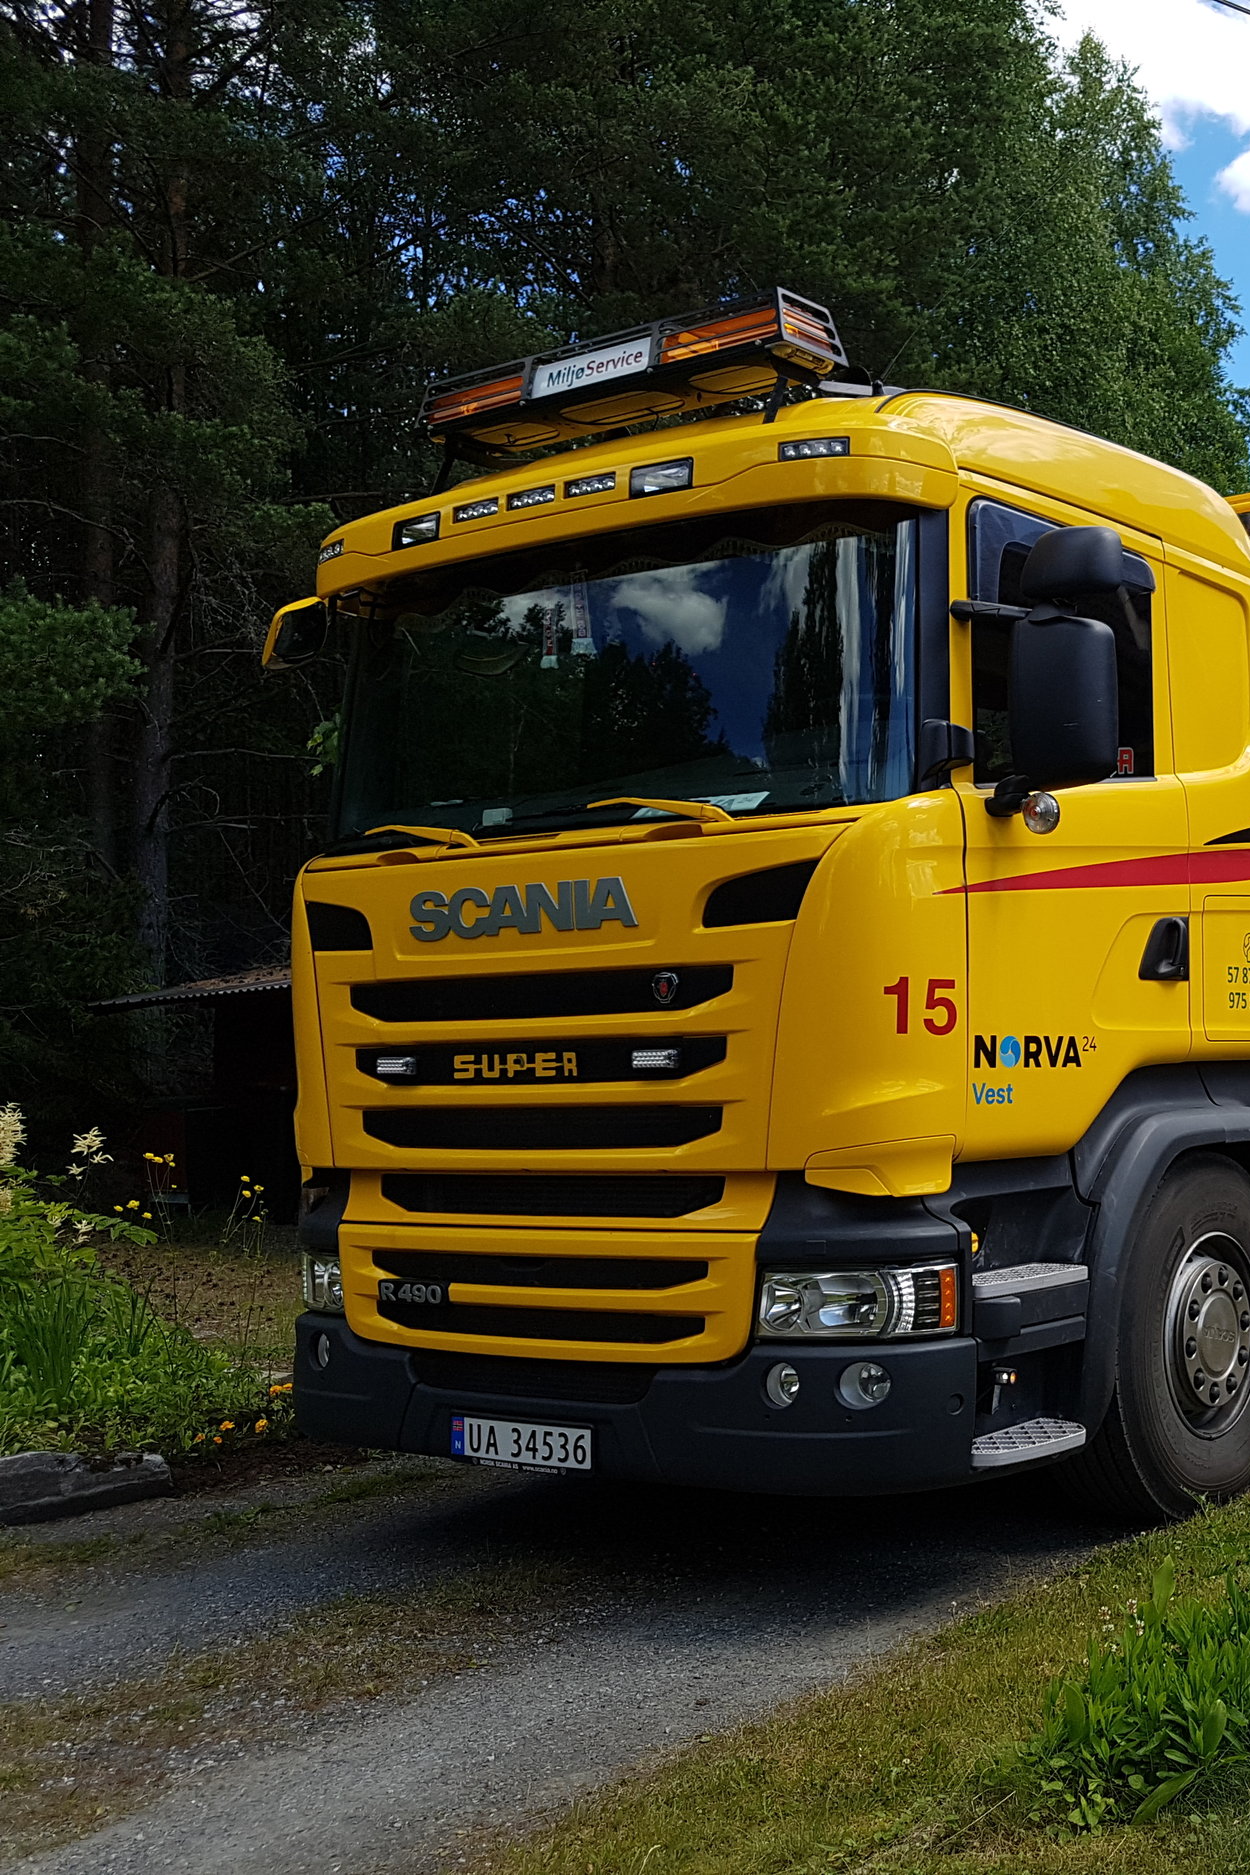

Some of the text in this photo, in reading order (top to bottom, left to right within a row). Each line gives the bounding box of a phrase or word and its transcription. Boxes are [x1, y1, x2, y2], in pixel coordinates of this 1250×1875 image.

[547, 350, 643, 388] MiljøService
[409, 876, 639, 942] SCANIA
[1227, 966, 1240, 983] 57
[884, 976, 958, 1036] 15
[1228, 992, 1247, 1009] 975
[453, 1052, 577, 1079] SUPER
[972, 1082, 1013, 1105] Vest
[380, 1282, 442, 1304] R 490
[469, 1422, 587, 1465] UA 34536
